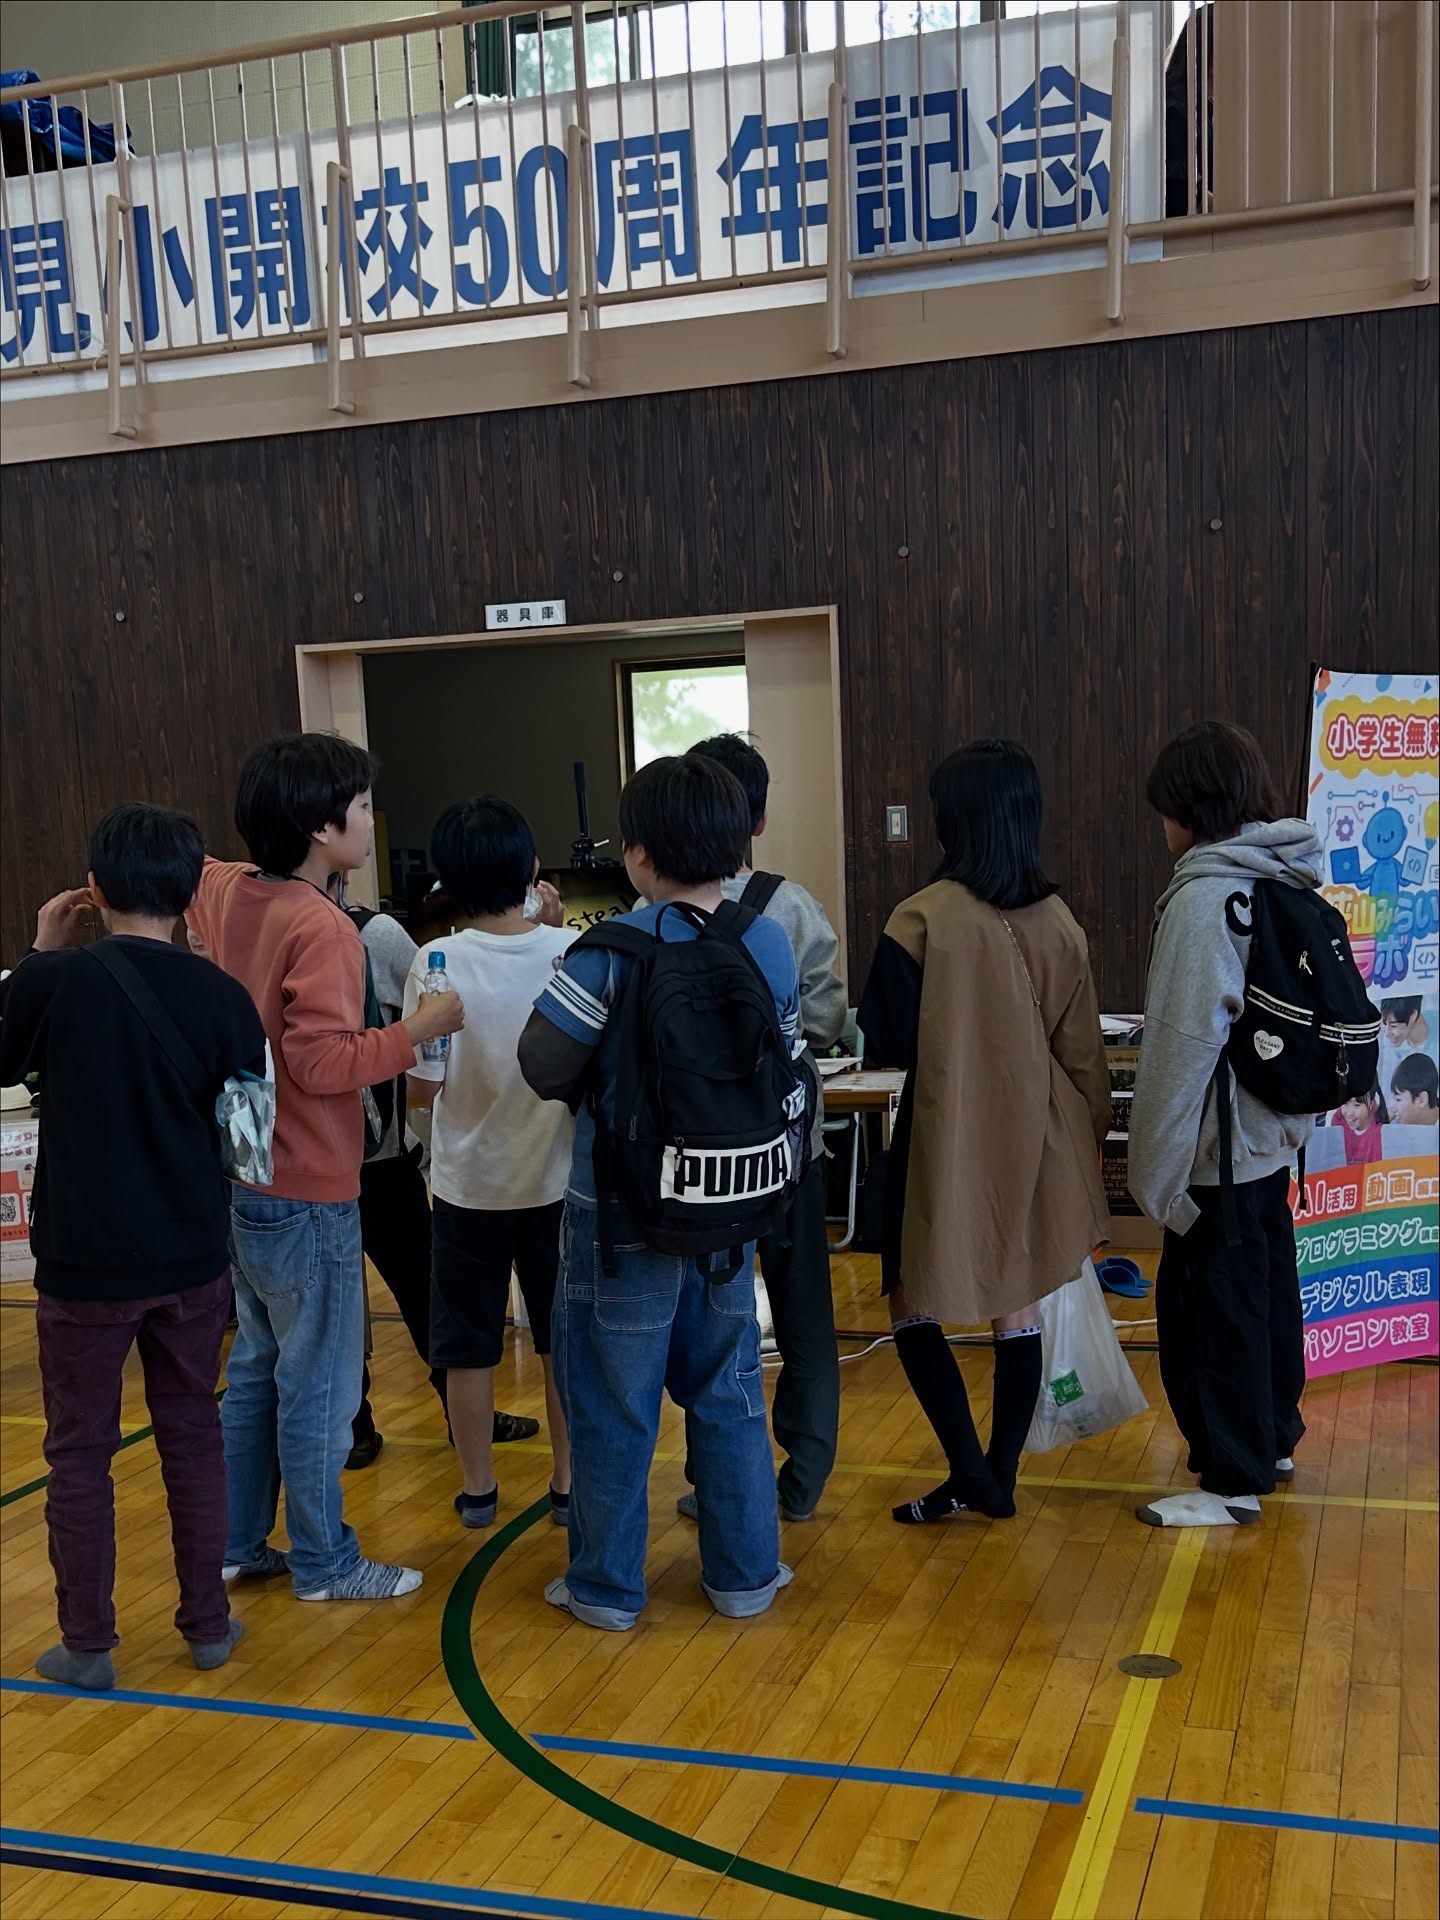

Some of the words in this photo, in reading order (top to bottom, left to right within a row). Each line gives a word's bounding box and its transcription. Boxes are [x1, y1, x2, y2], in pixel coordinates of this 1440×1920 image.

[674, 1140, 788, 1197] PUMA
[1300, 1267, 1431, 1319] デジタル表現
